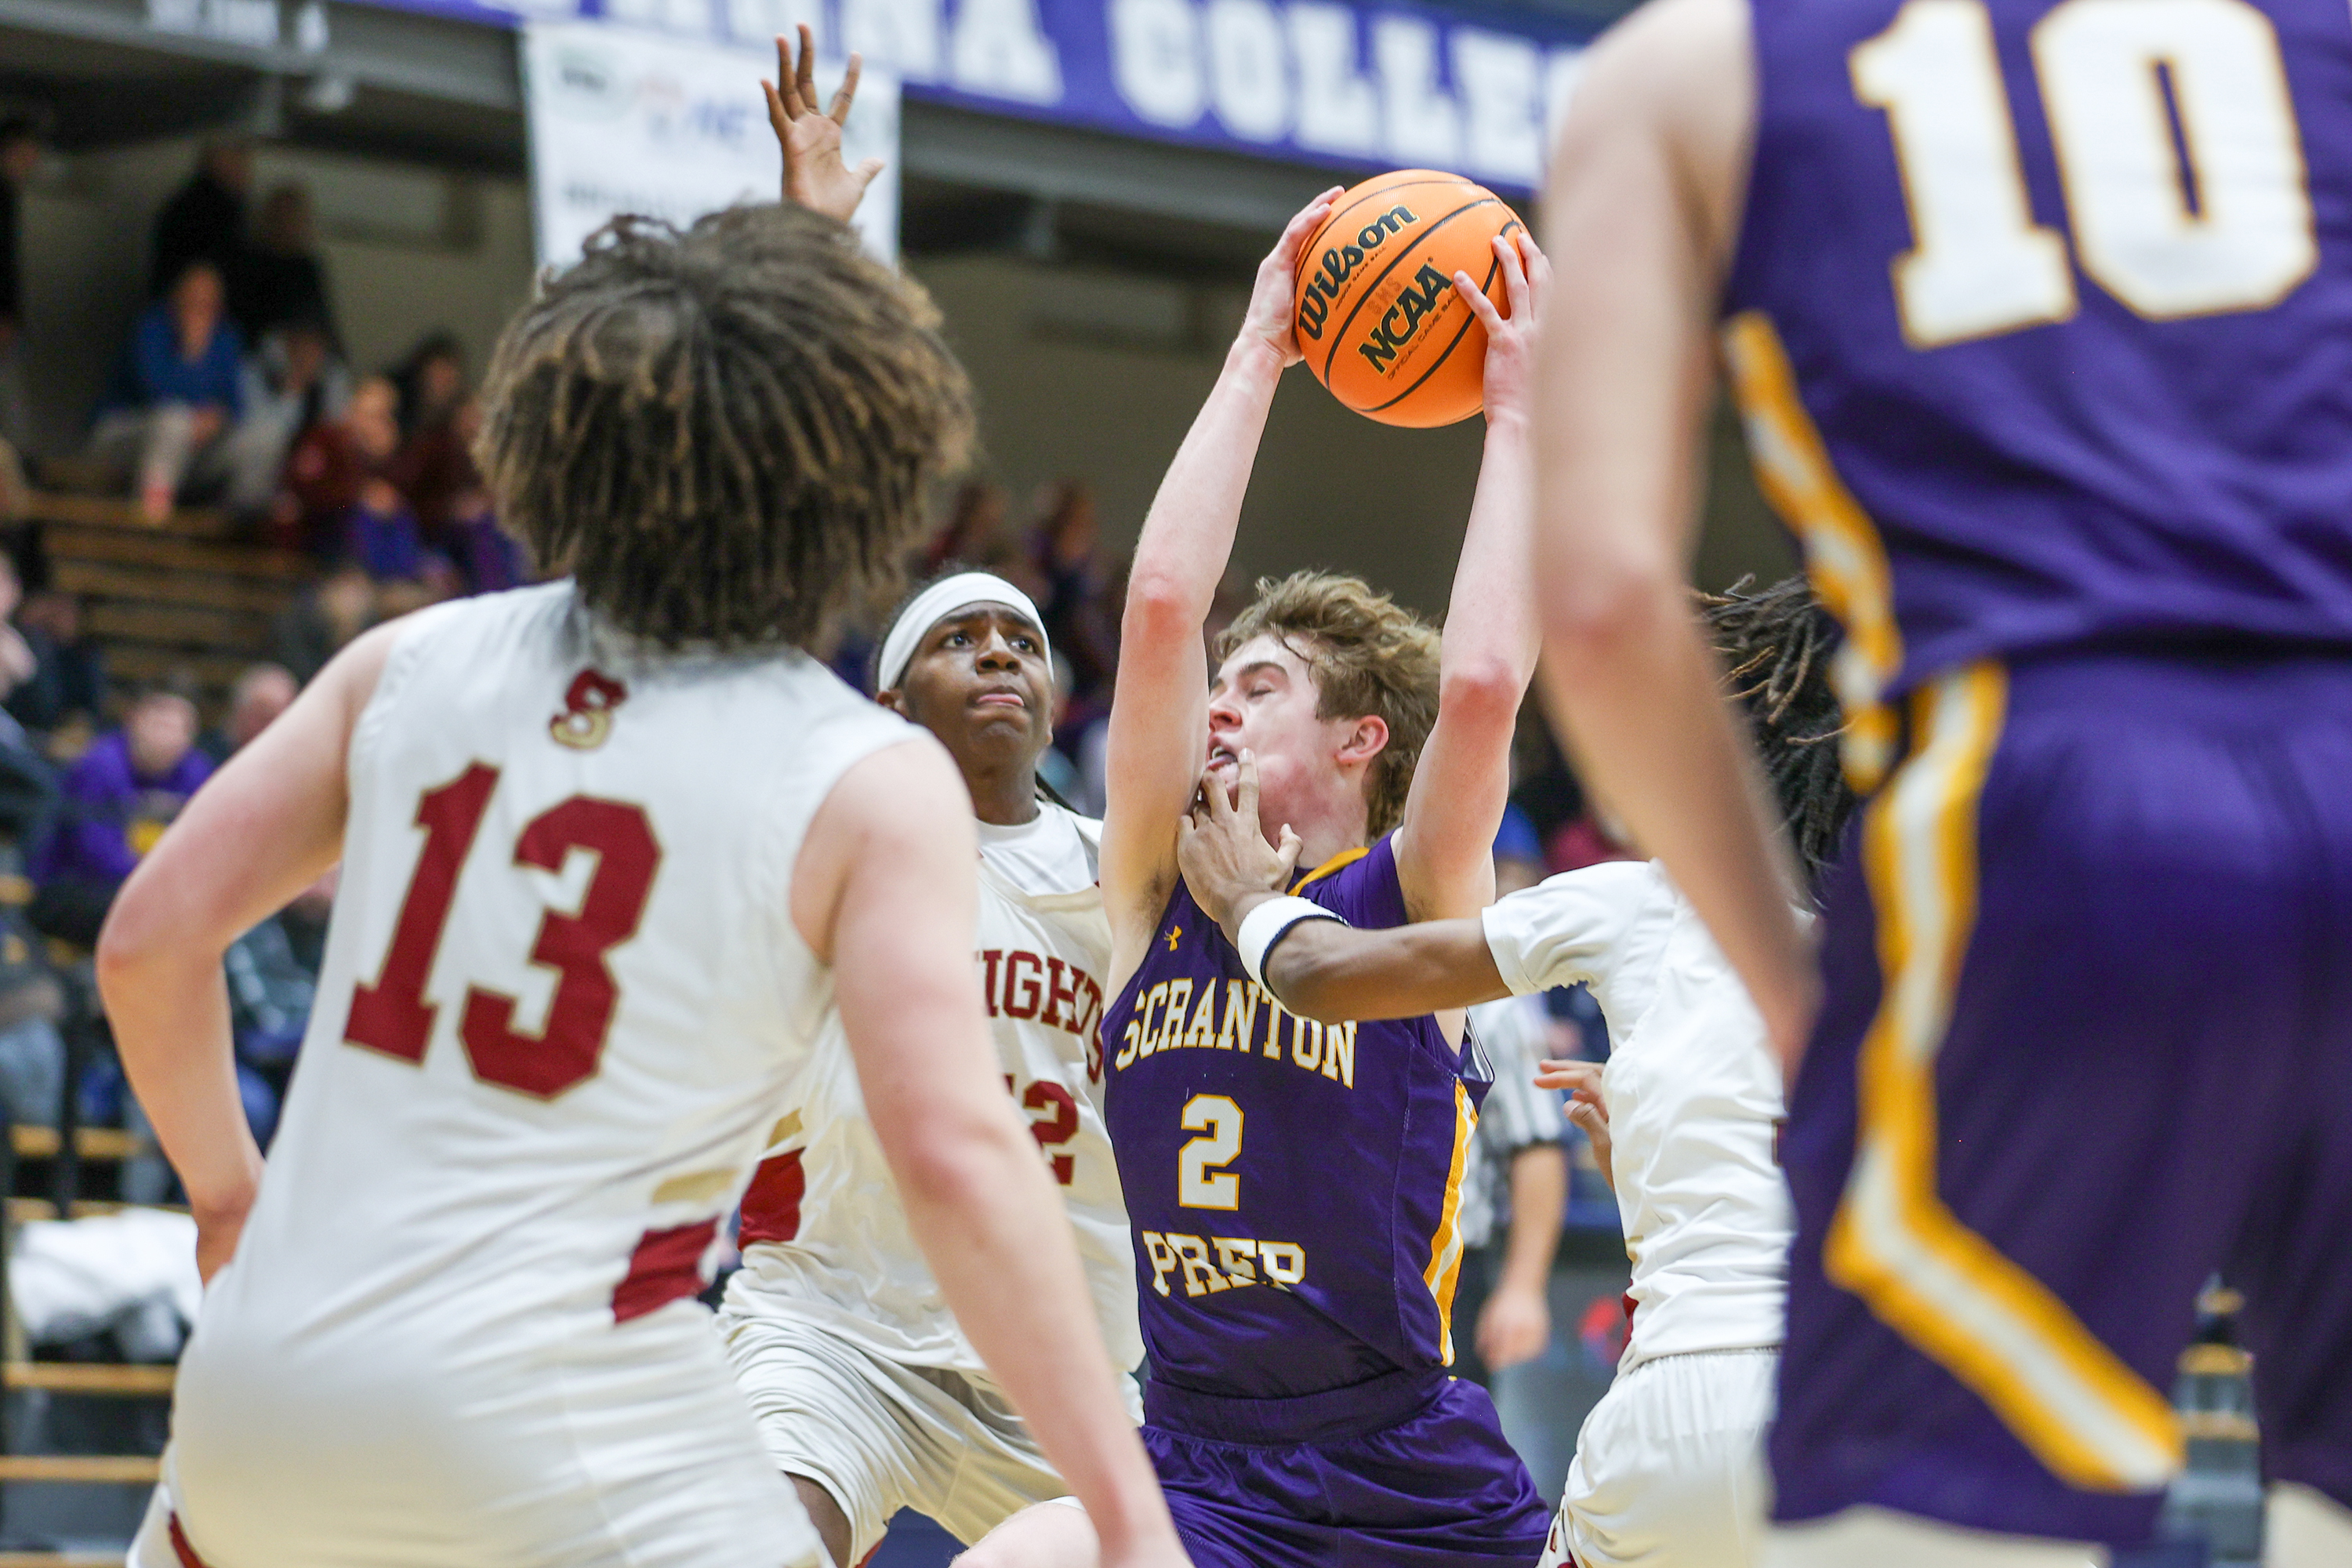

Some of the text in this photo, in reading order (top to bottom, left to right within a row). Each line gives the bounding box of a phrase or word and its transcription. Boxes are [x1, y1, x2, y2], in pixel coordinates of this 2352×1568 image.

[1846, 0, 2323, 351] 10
[1298, 204, 1421, 341] Wilson
[1358, 262, 1454, 376] NCAA
[1417, 314, 1442, 342] GAME
[548, 666, 631, 751] S
[341, 756, 666, 1105] 13
[1114, 976, 1358, 1090] SCRANTON
[1004, 1072, 1080, 1187] 2
[1178, 1093, 1245, 1211] 2
[1142, 1230, 1306, 1298] PREP
